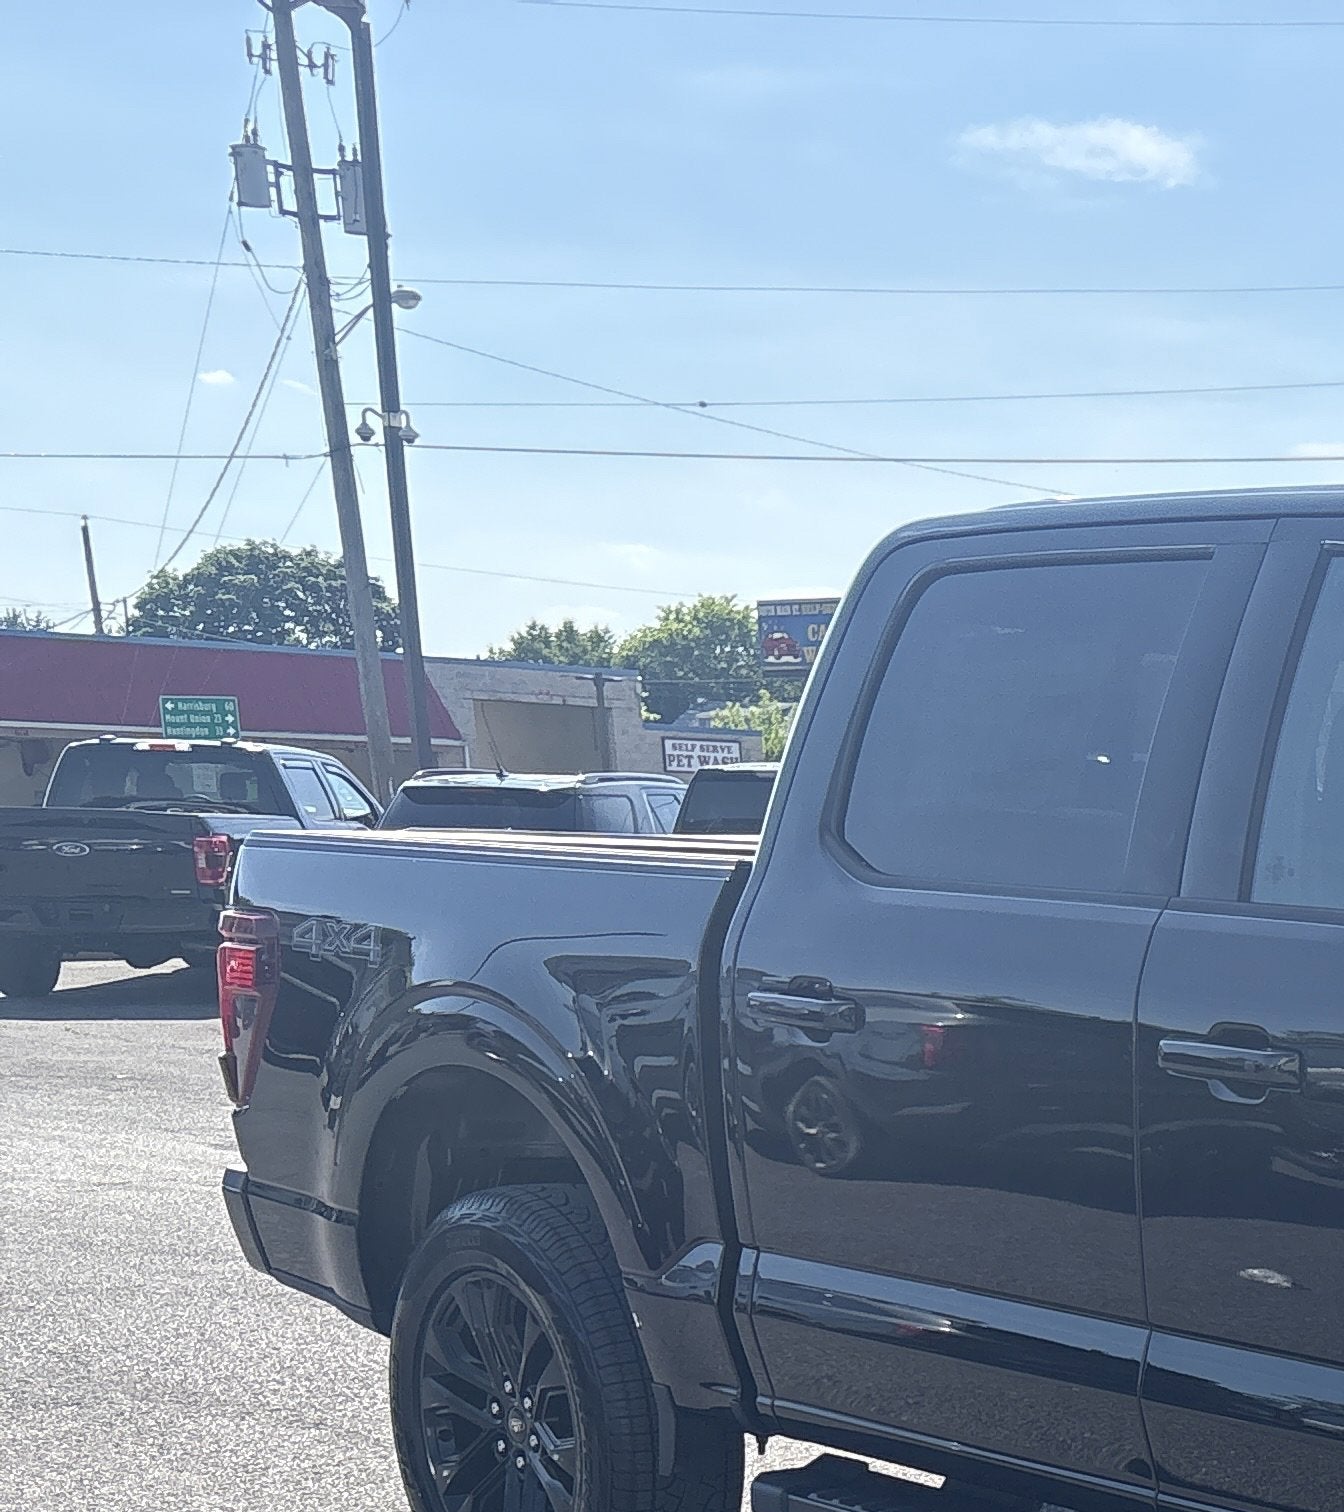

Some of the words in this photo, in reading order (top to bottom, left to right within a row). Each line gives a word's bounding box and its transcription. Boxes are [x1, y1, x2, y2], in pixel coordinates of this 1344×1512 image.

[177, 701, 217, 713] Harrisburg
[165, 714, 188, 723] Mount
[190, 714, 211, 723] Union
[671, 743, 697, 753] SELF
[700, 744, 733, 755] SERVE
[666, 754, 694, 768] PET
